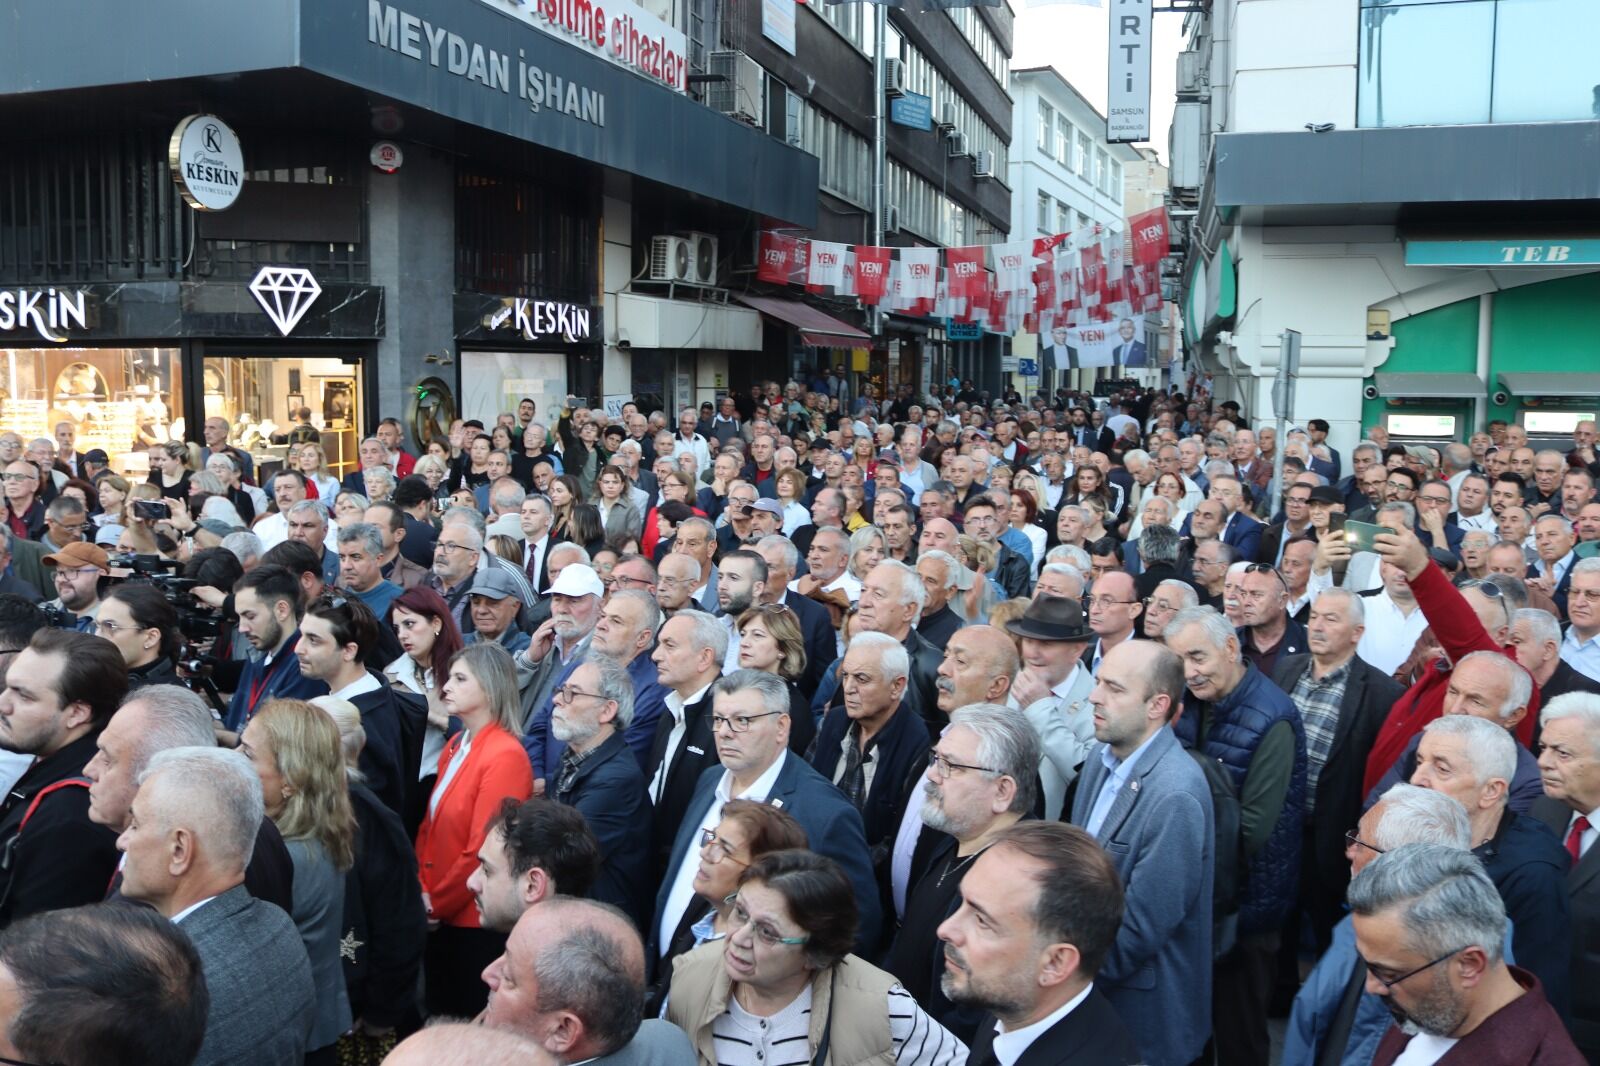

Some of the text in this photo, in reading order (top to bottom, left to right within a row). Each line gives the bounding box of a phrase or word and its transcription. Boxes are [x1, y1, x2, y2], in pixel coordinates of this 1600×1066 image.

[368, 0, 605, 127] MEYDAN İŞHANI
[1111, 107, 1145, 116] SAMSUN
[186, 163, 239, 187] KESKİN
[1501, 245, 1571, 263] TEB
